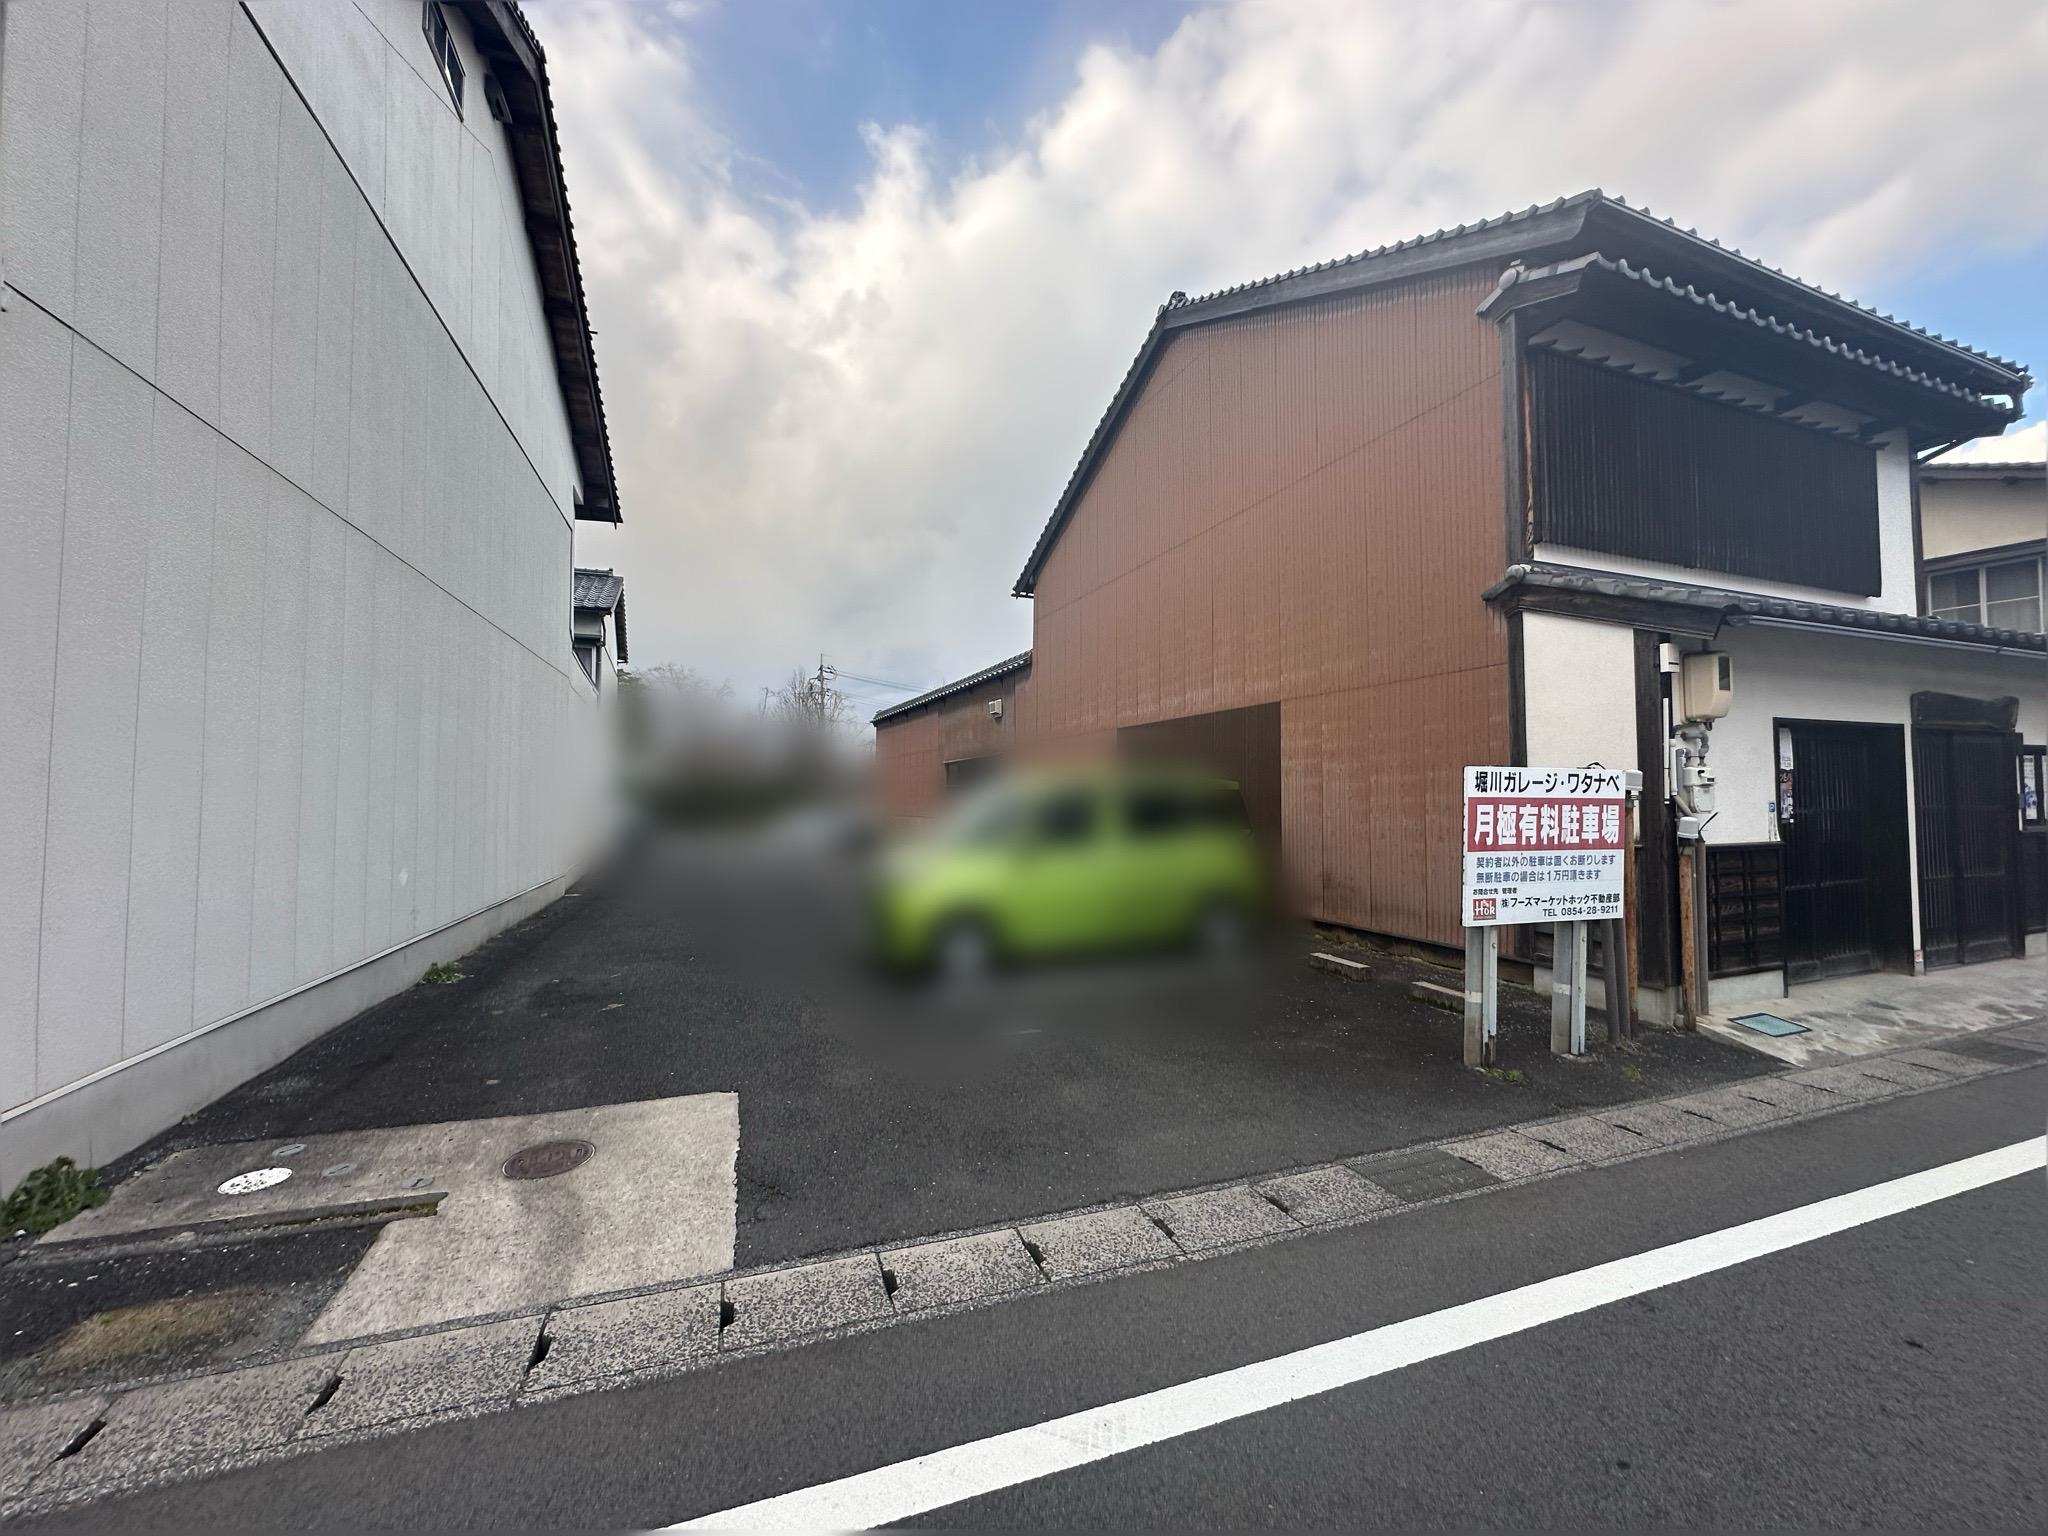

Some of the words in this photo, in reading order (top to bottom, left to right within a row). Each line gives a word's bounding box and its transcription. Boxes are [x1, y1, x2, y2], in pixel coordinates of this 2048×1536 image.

[1474, 803, 1620, 845] 月極有料駐車場
[1476, 855, 1616, 869] 契約者以外の駐車は固くお断りします
[1543, 909, 1557, 917] TEL
[1561, 906, 1618, 916] 0854-28-9211
